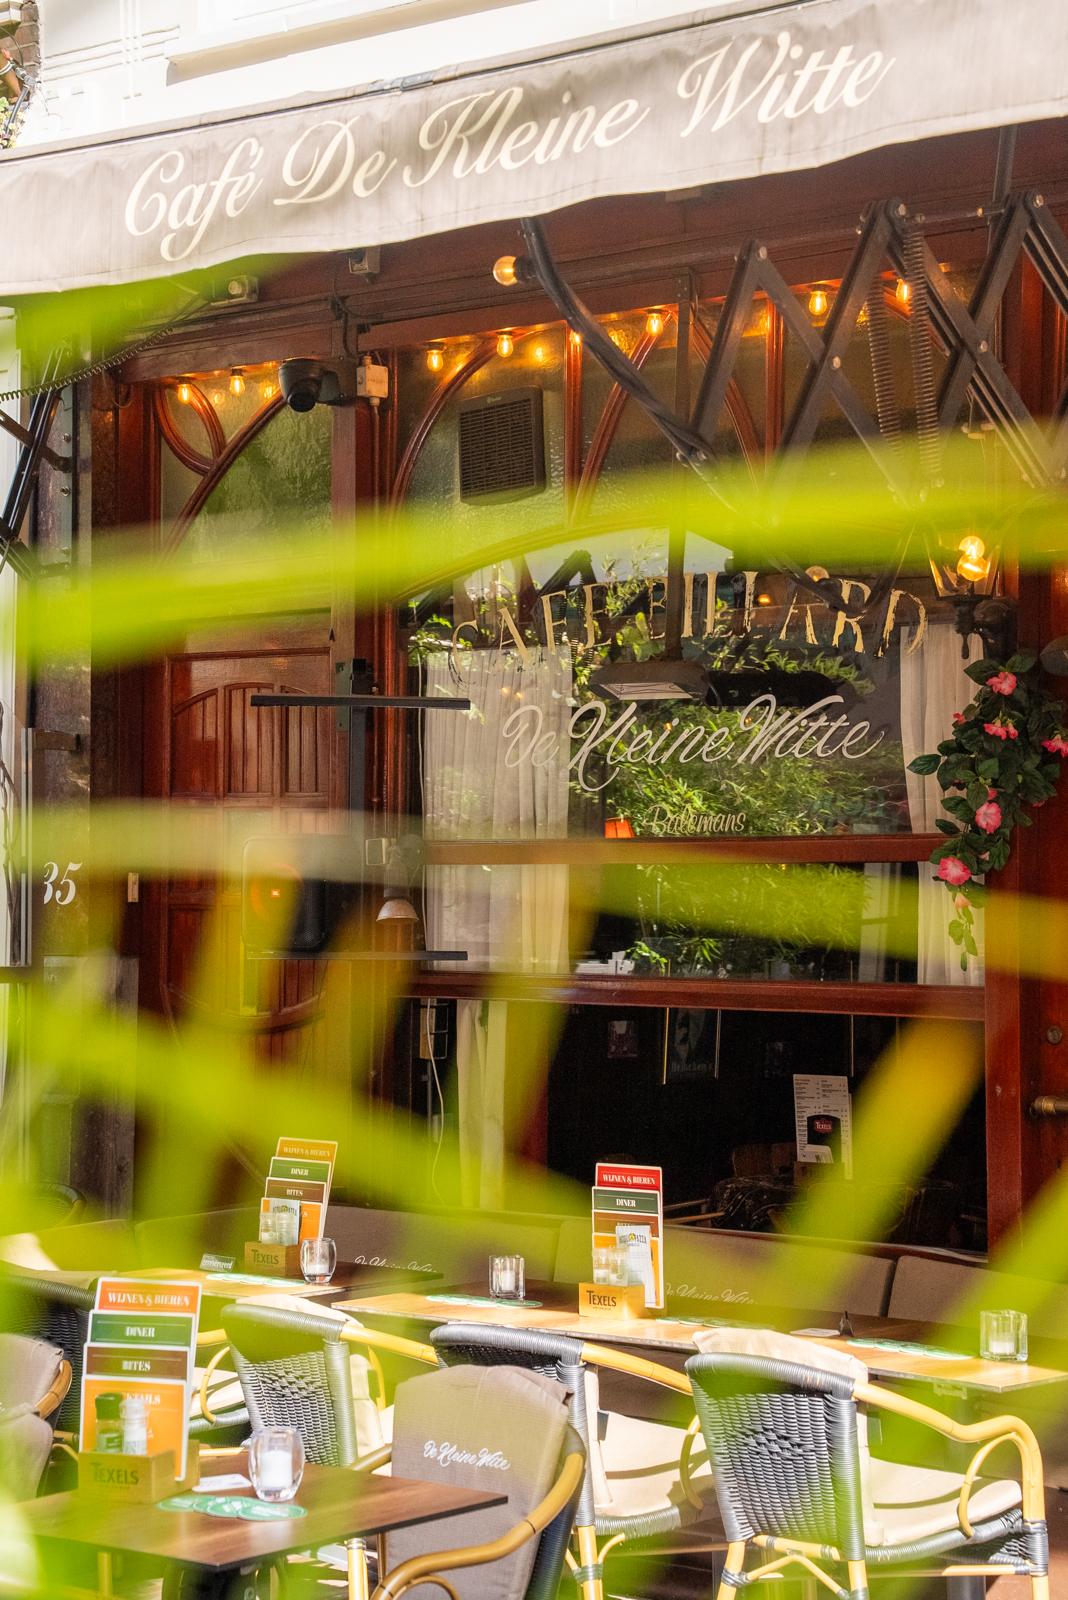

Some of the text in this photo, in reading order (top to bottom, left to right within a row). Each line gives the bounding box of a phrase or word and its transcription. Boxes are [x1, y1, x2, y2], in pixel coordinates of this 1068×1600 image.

[125, 30, 895, 264] Café De Kleine Witte
[502, 694, 885, 792] De Kleine Witte
[43, 861, 83, 906] 35
[602, 1173, 627, 1184] WIJNEN
[632, 1176, 656, 1186] BIEREN
[616, 1198, 637, 1208] DINER
[251, 1249, 280, 1265] TEXELS
[107, 1291, 145, 1305] WIJNEN
[153, 1294, 190, 1307] BIEREN
[586, 1290, 617, 1307] TEXELS
[125, 1326, 155, 1338] DINER
[122, 1361, 151, 1371] BITES
[437, 1441, 478, 1468] Kleine
[476, 1447, 511, 1471] Witte
[91, 1462, 139, 1484] TEXELS
